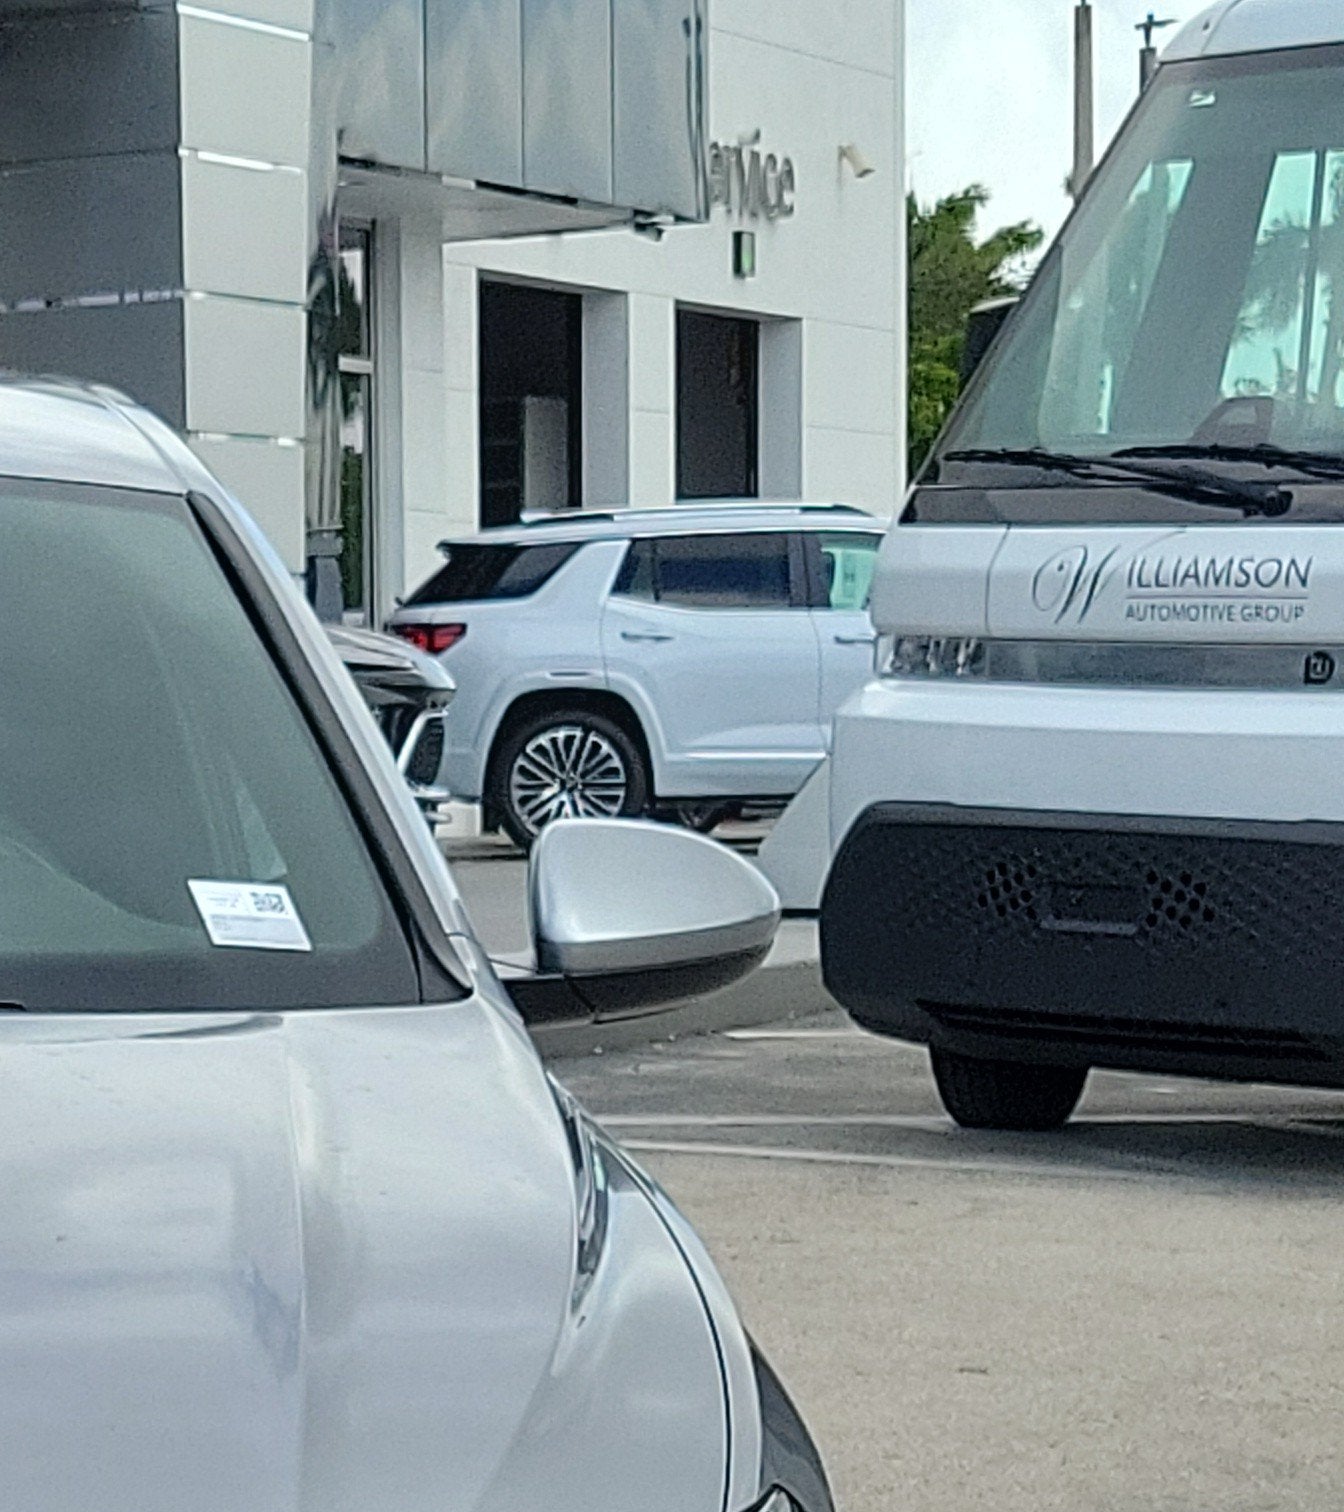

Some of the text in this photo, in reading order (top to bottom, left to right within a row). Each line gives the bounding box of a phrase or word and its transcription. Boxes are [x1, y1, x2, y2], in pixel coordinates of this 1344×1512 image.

[1032, 528, 1314, 624] WILLIAMSON
[1125, 604, 1305, 624] AUTOMOTIVE GROUP
